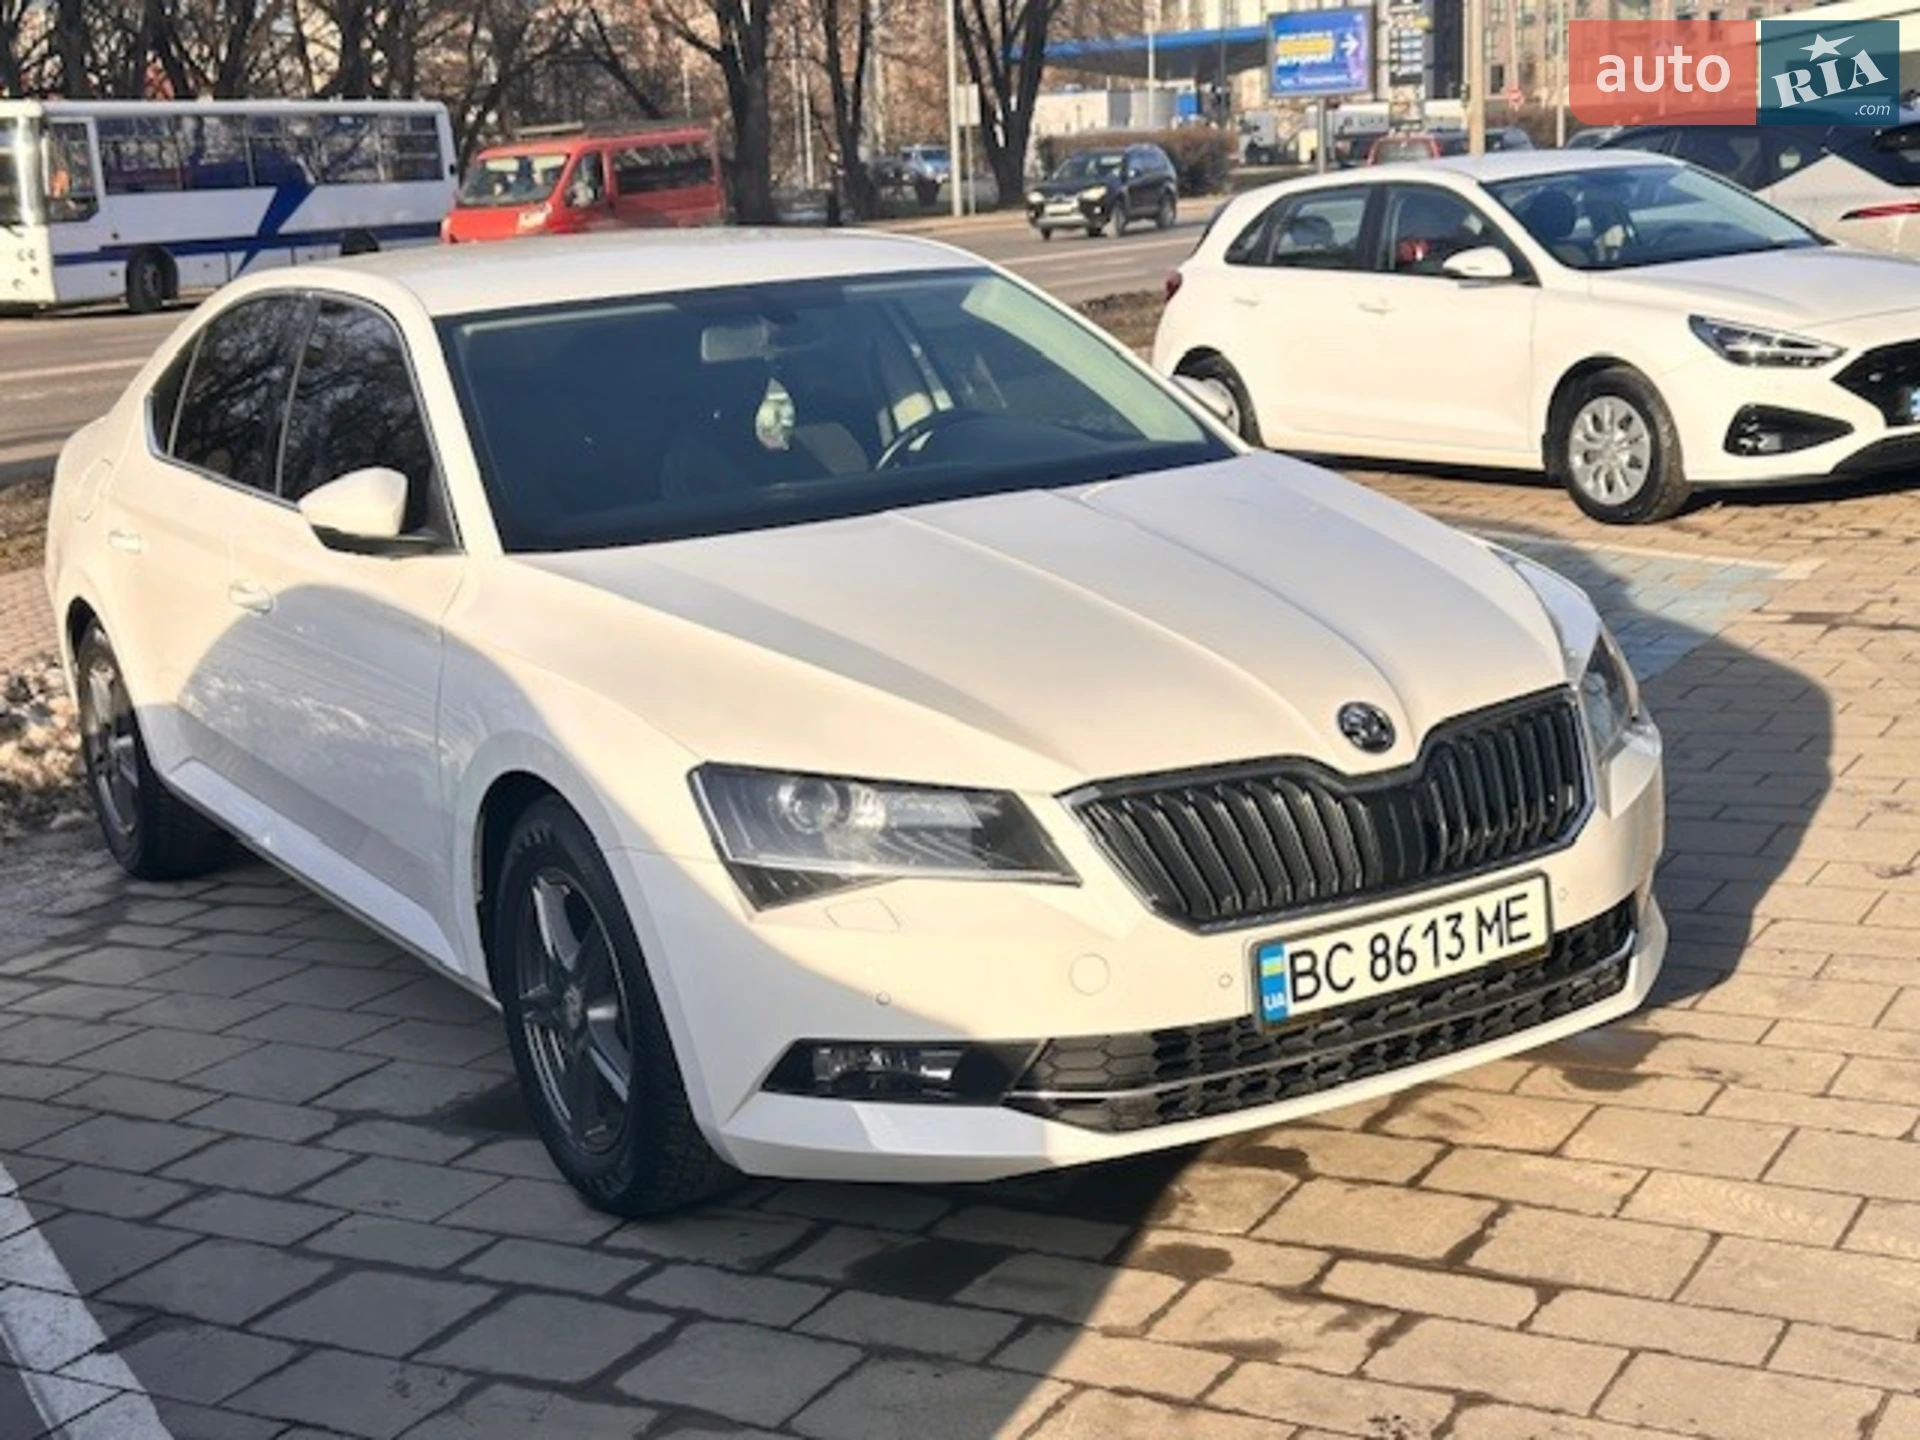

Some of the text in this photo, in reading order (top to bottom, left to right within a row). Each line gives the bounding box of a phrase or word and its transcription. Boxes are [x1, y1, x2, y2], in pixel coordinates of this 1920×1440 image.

[1289, 893, 1532, 1002] BC 8613 ME
[1263, 993, 1285, 1011] UA
